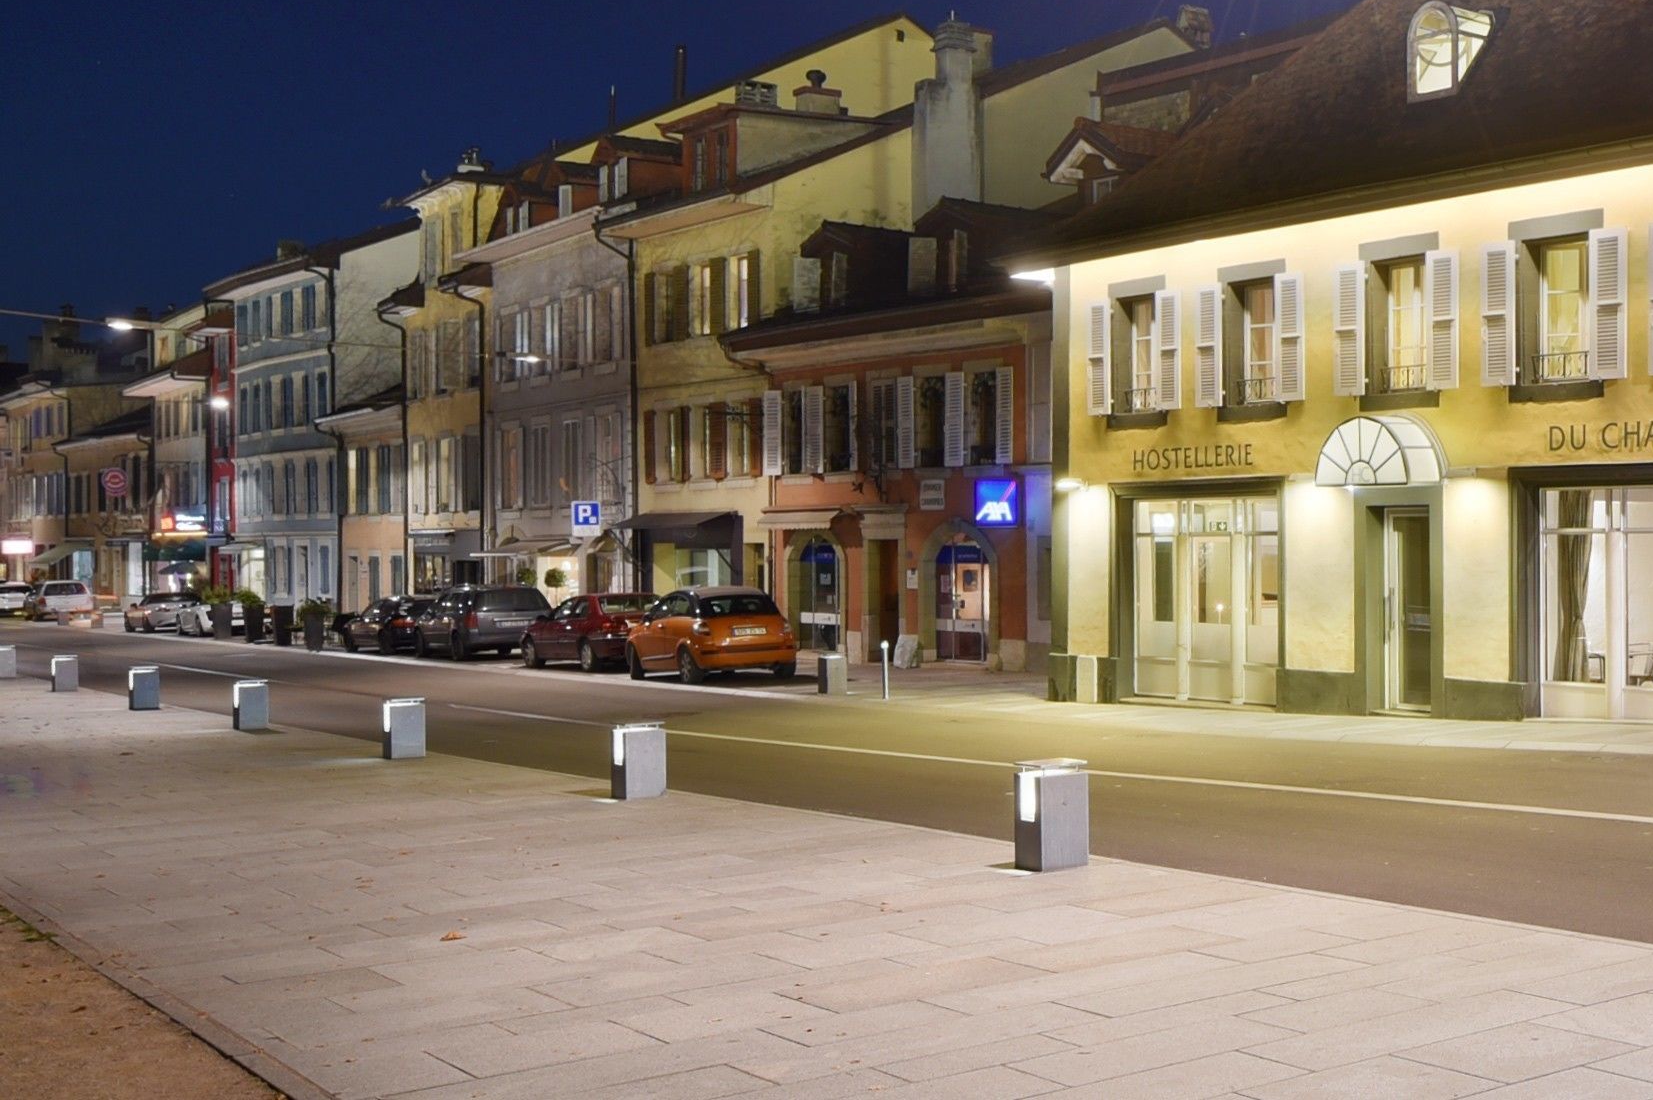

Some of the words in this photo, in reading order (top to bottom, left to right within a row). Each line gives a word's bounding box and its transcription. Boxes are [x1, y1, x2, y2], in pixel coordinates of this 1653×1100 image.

[1549, 424, 1586, 451] DU
[1133, 443, 1254, 471] HOSTELLERIE
[578, 505, 591, 523] P
[976, 501, 1013, 521] AXA
